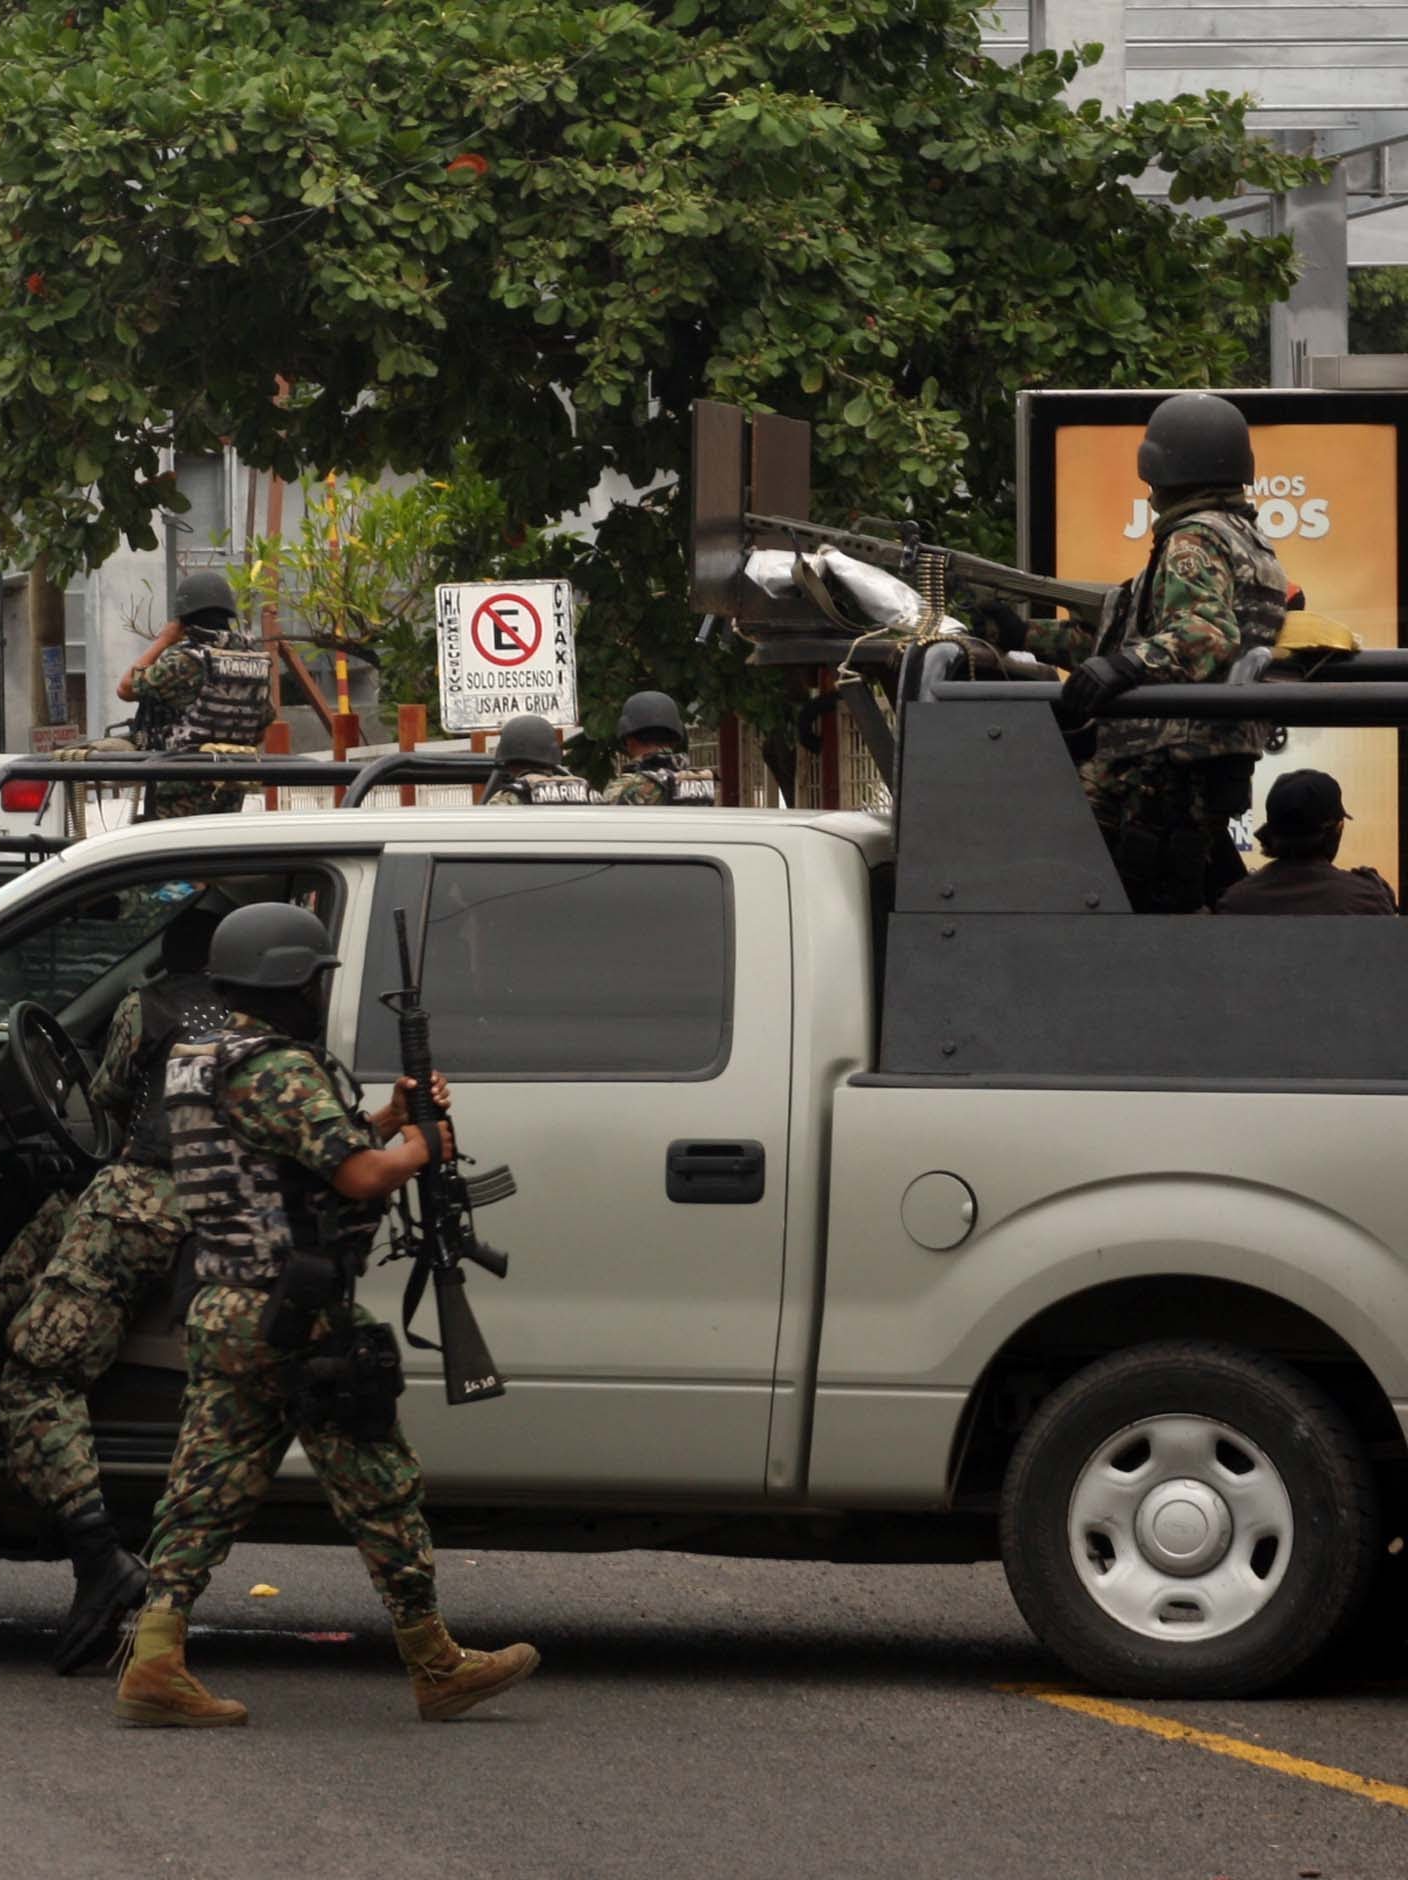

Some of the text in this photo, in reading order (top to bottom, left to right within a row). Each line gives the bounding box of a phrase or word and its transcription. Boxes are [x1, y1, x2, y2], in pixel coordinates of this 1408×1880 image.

[466, 670, 553, 689] SOLO DESCENSO
[477, 696, 520, 714] USARA
